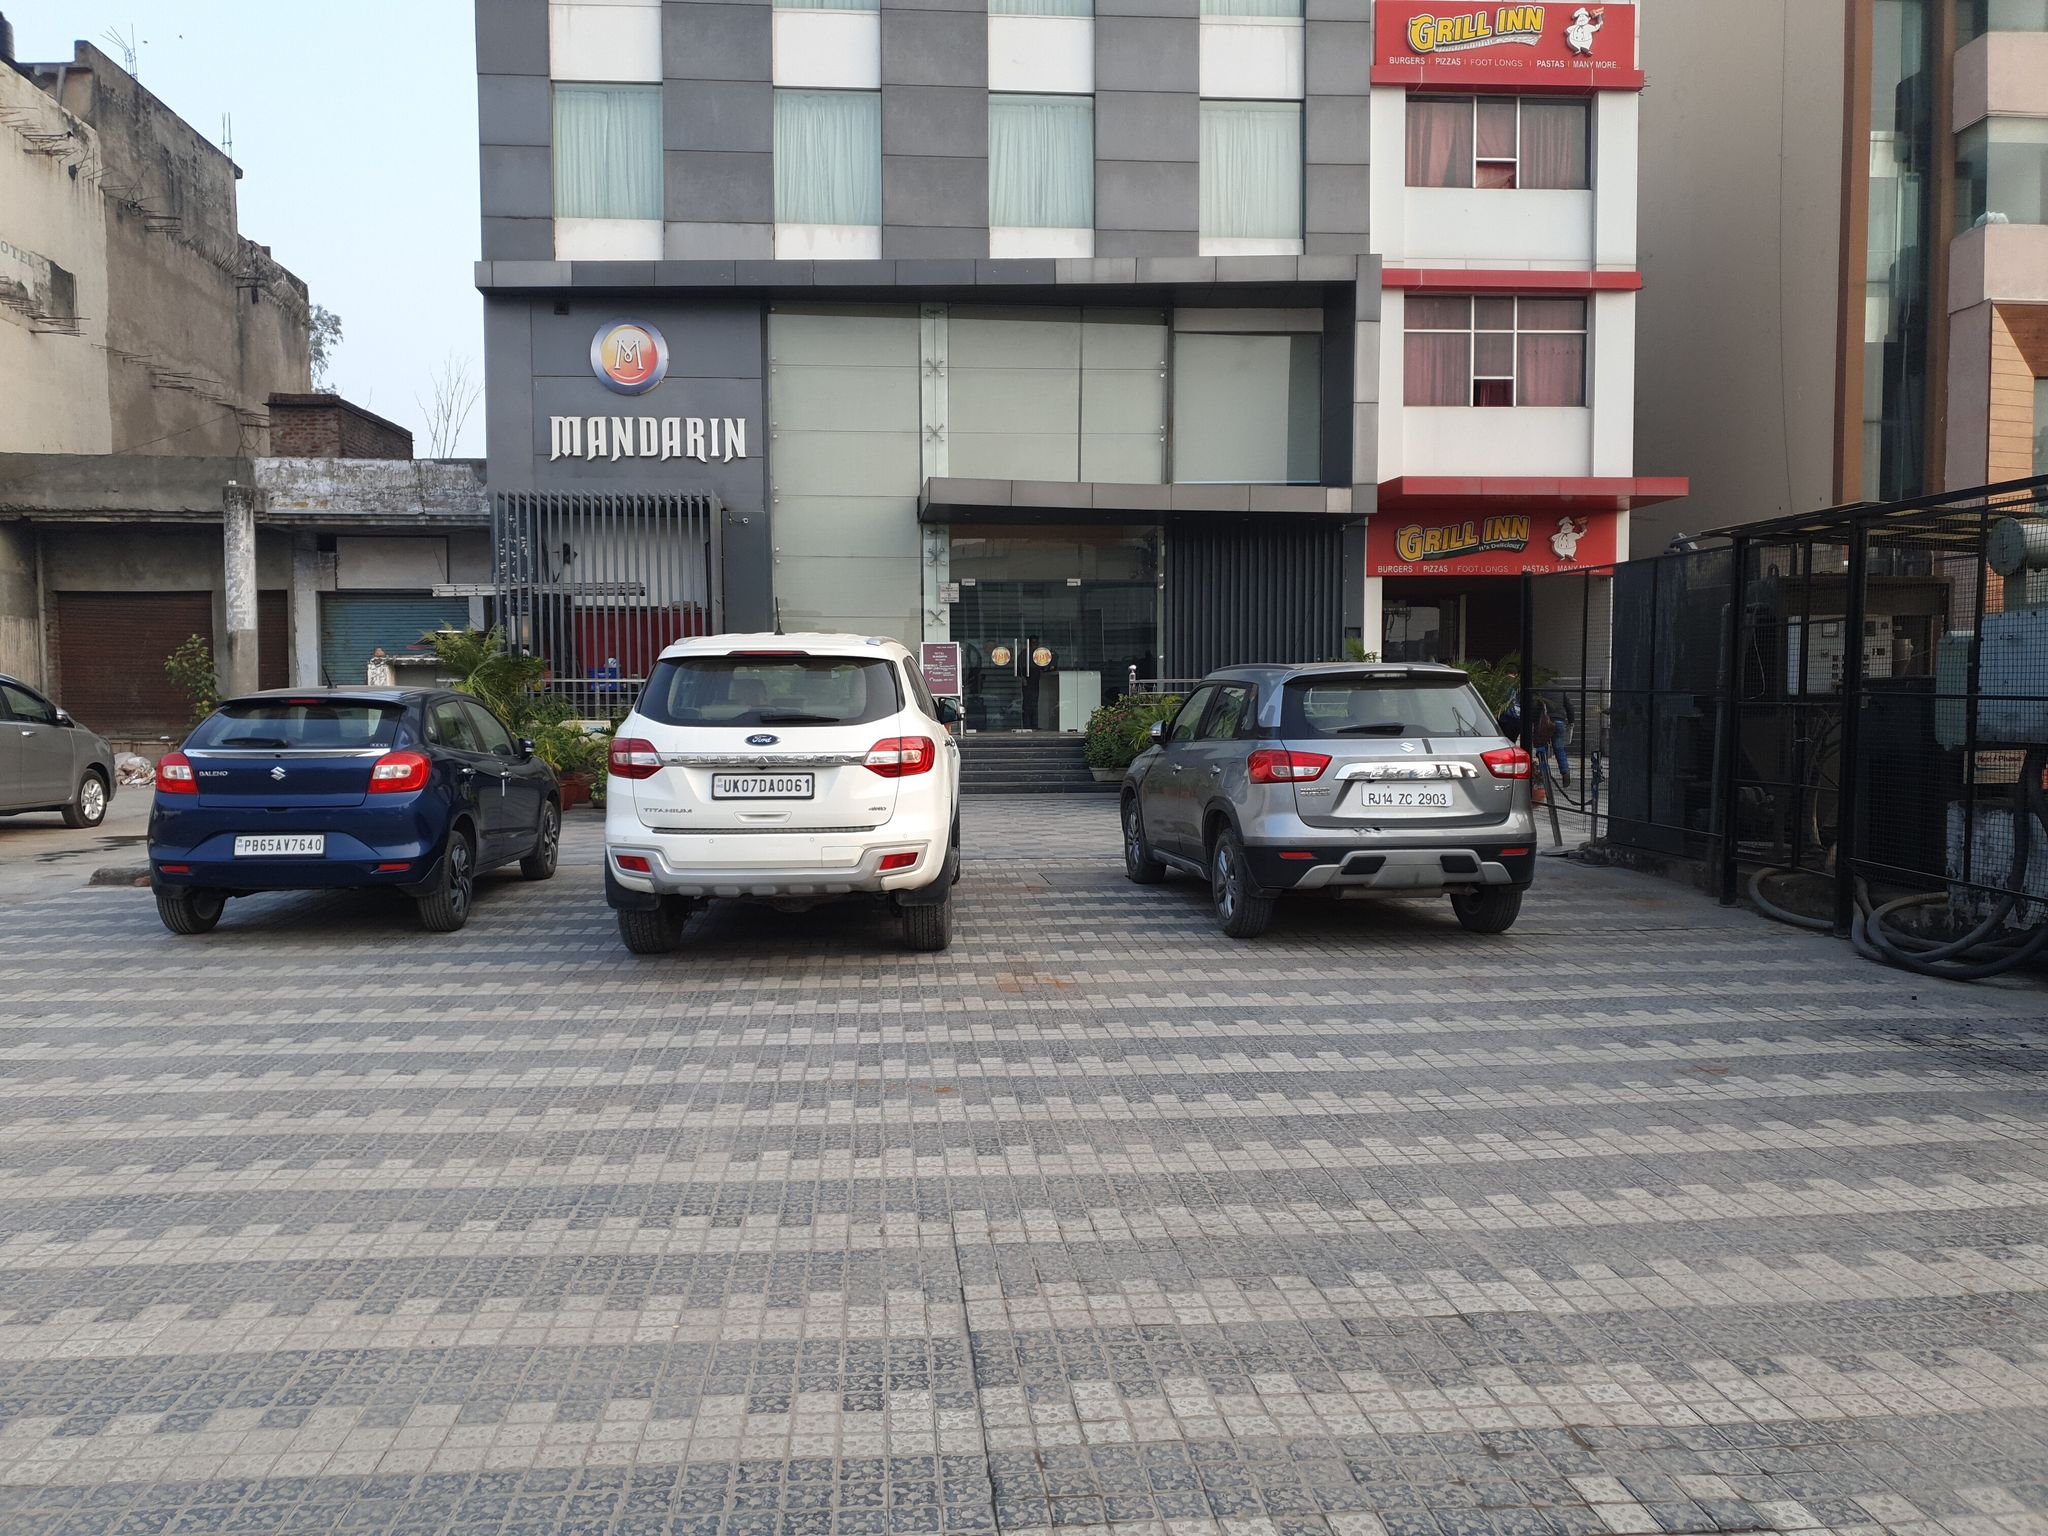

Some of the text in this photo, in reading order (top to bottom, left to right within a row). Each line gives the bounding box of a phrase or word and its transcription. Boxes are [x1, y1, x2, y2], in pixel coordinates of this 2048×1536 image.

[1409, 7, 1545, 52] GRILL INN
[1389, 56, 1425, 65] BURGERS
[1435, 57, 1461, 66] PIZZAS
[1470, 58, 1492, 67] FOOT
[1495, 58, 1523, 67] LONGS
[1536, 59, 1565, 68] PASTAS
[1573, 60, 1594, 69] MANY
[549, 416, 748, 464] MANDARIN
[1397, 515, 1530, 561] GRILL INN
[1377, 565, 1413, 573] BURGERS
[1423, 565, 1448, 573] PIZZAS
[1457, 565, 1479, 573] FOOT
[1480, 565, 1509, 573] LONGS
[1521, 564, 1550, 573] PASTAS
[752, 735, 773, 744] Ford
[723, 778, 811, 793] UK07DA0061
[1368, 793, 1447, 805] RJ14 ZC 2903
[244, 838, 322, 853] PB65AV7640
